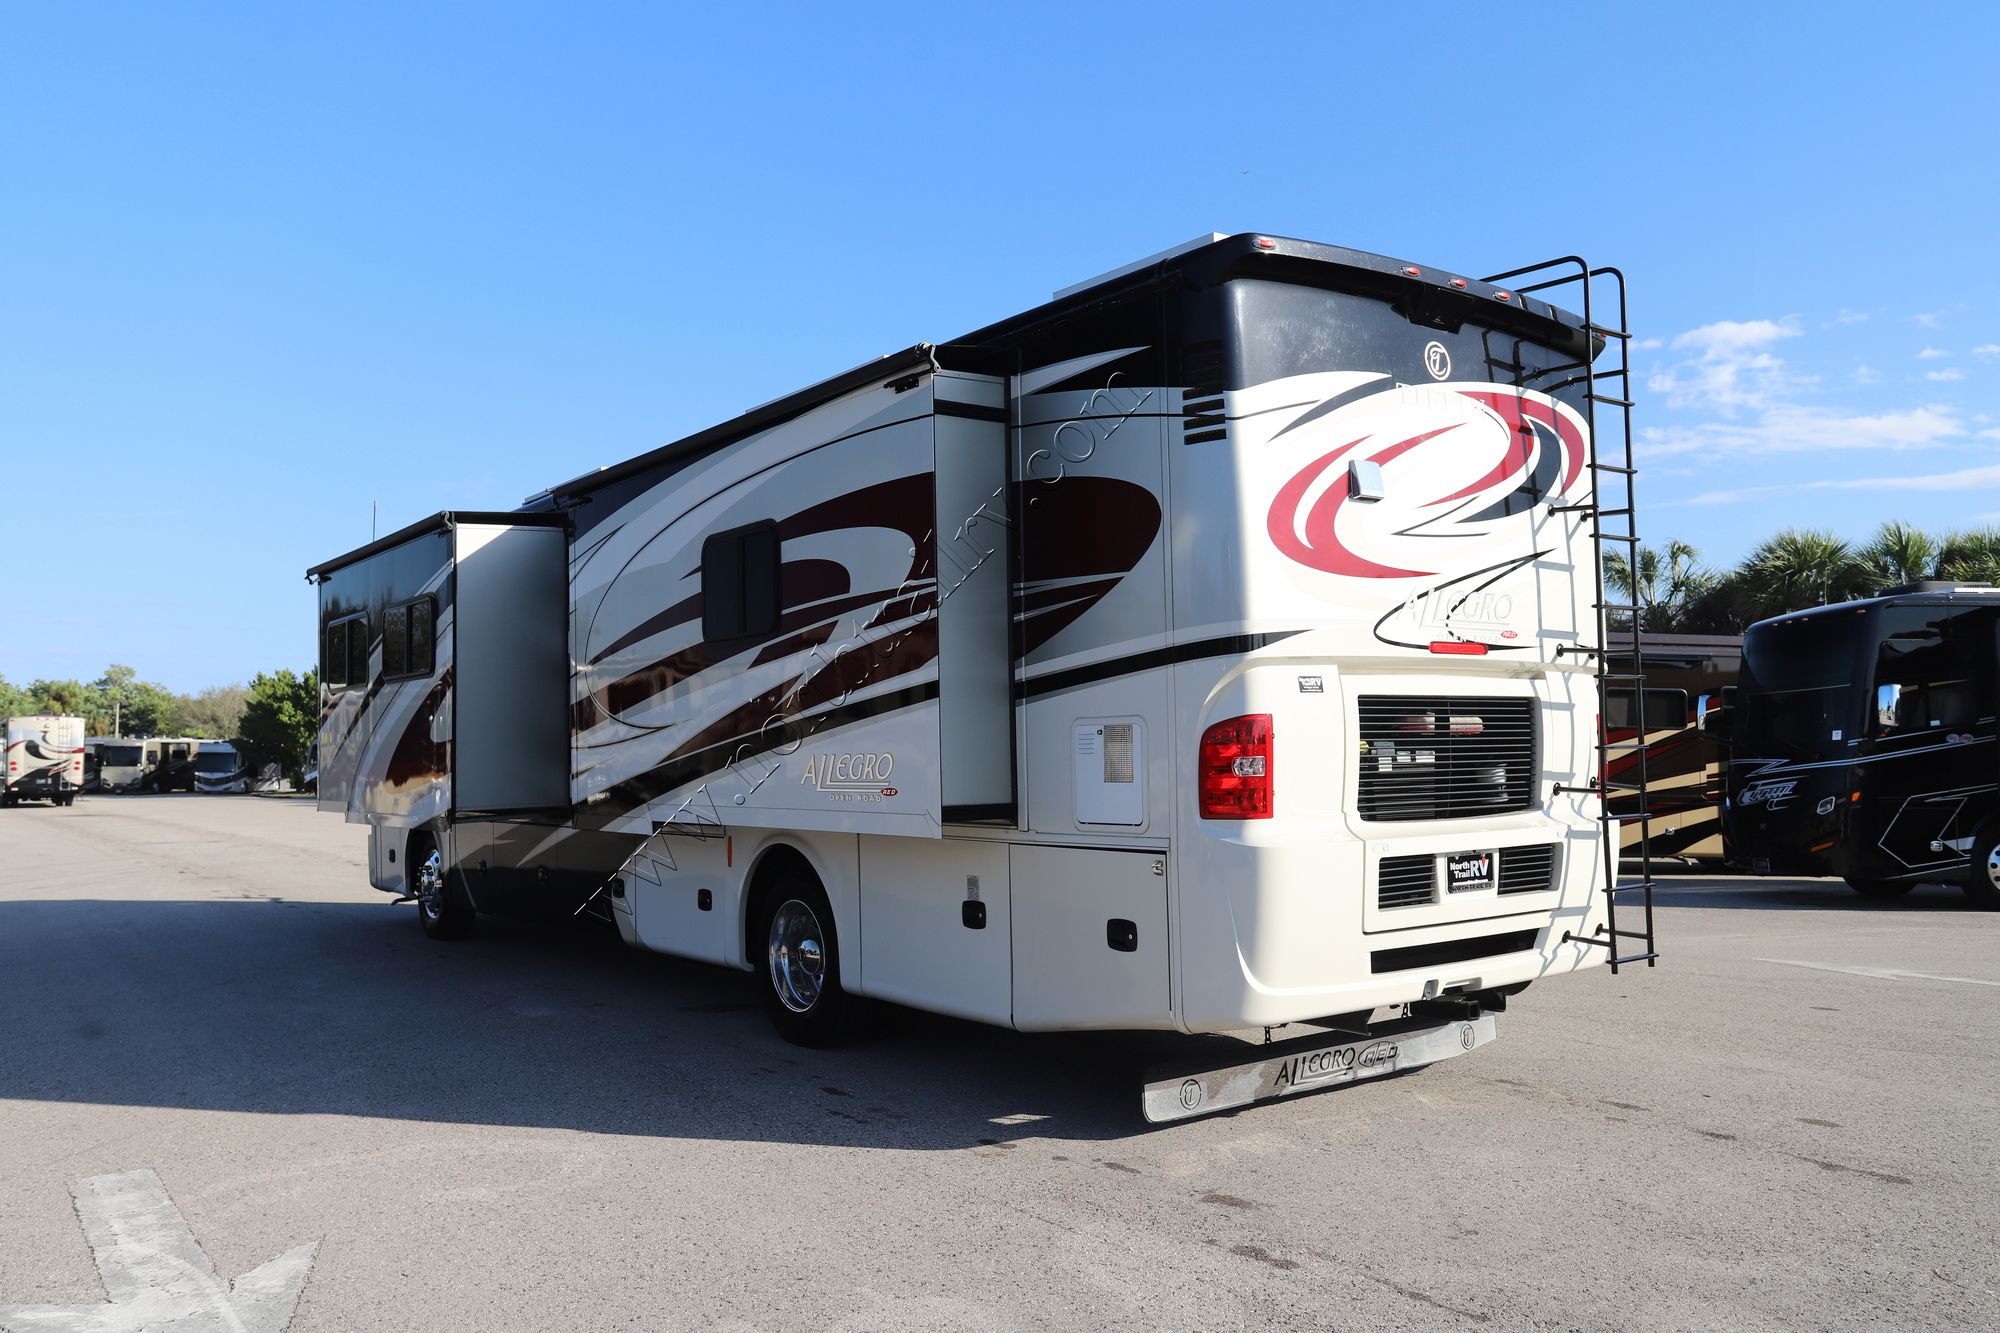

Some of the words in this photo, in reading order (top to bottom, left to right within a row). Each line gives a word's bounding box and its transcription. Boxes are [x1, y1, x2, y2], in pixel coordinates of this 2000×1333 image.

[1395, 586, 1513, 630] ALLEGRO
[800, 752, 894, 791] ALLEGRO
[829, 794, 853, 802] OPEN
[857, 794, 882, 803] ROAD
[882, 788, 897, 796] RED
[1450, 861, 1470, 871] North
[1470, 858, 1489, 877] RV
[1454, 870, 1470, 879] Trail
[1274, 1047, 1356, 1086] ALLEGRO
